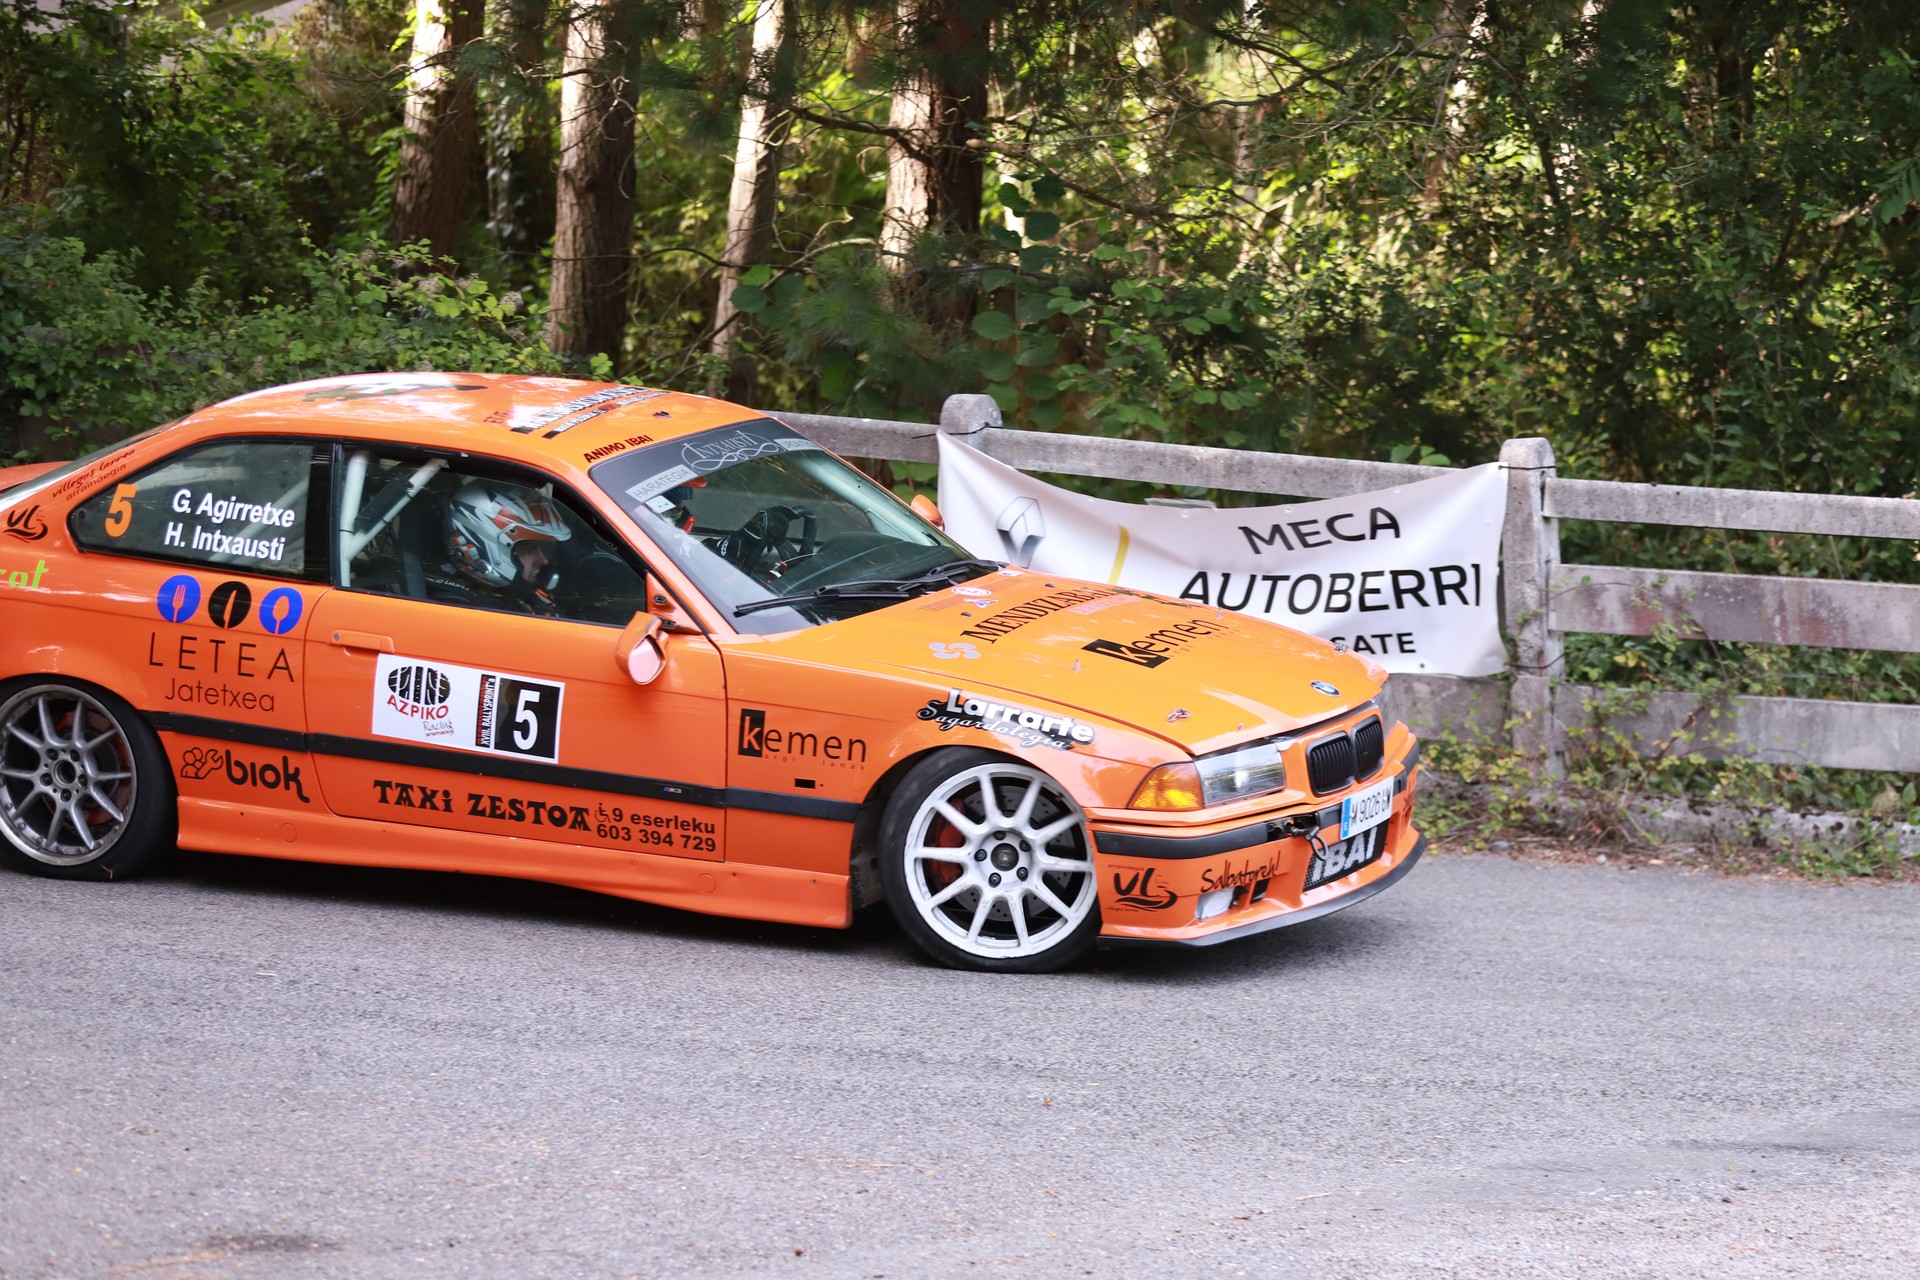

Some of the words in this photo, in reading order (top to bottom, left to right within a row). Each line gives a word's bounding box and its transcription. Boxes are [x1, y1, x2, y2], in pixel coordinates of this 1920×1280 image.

[583, 441, 625, 464] ANIMO
[625, 434, 654, 448] IBAI
[105, 482, 138, 538] 5
[172, 488, 192, 514] G.
[195, 491, 296, 528] Agirretxe
[164, 521, 186, 548] H.
[192, 525, 286, 561] Intxausti
[1238, 506, 1401, 555] MECA
[1178, 563, 1481, 616] AUTOBERRI
[149, 631, 295, 682] LETEA
[165, 678, 275, 712] Jatetxea
[387, 694, 449, 720] AZPIKO
[946, 687, 1094, 743] Larrarte
[513, 689, 541, 750] 5
[738, 708, 867, 762] kemen
[467, 793, 592, 832] ZESTOA
[612, 807, 623, 823] 9
[630, 813, 715, 834] eserleku
[1359, 792, 1381, 822] 9026
[597, 824, 632, 841] 603
[638, 829, 674, 846] 394
[680, 834, 716, 852] 729
